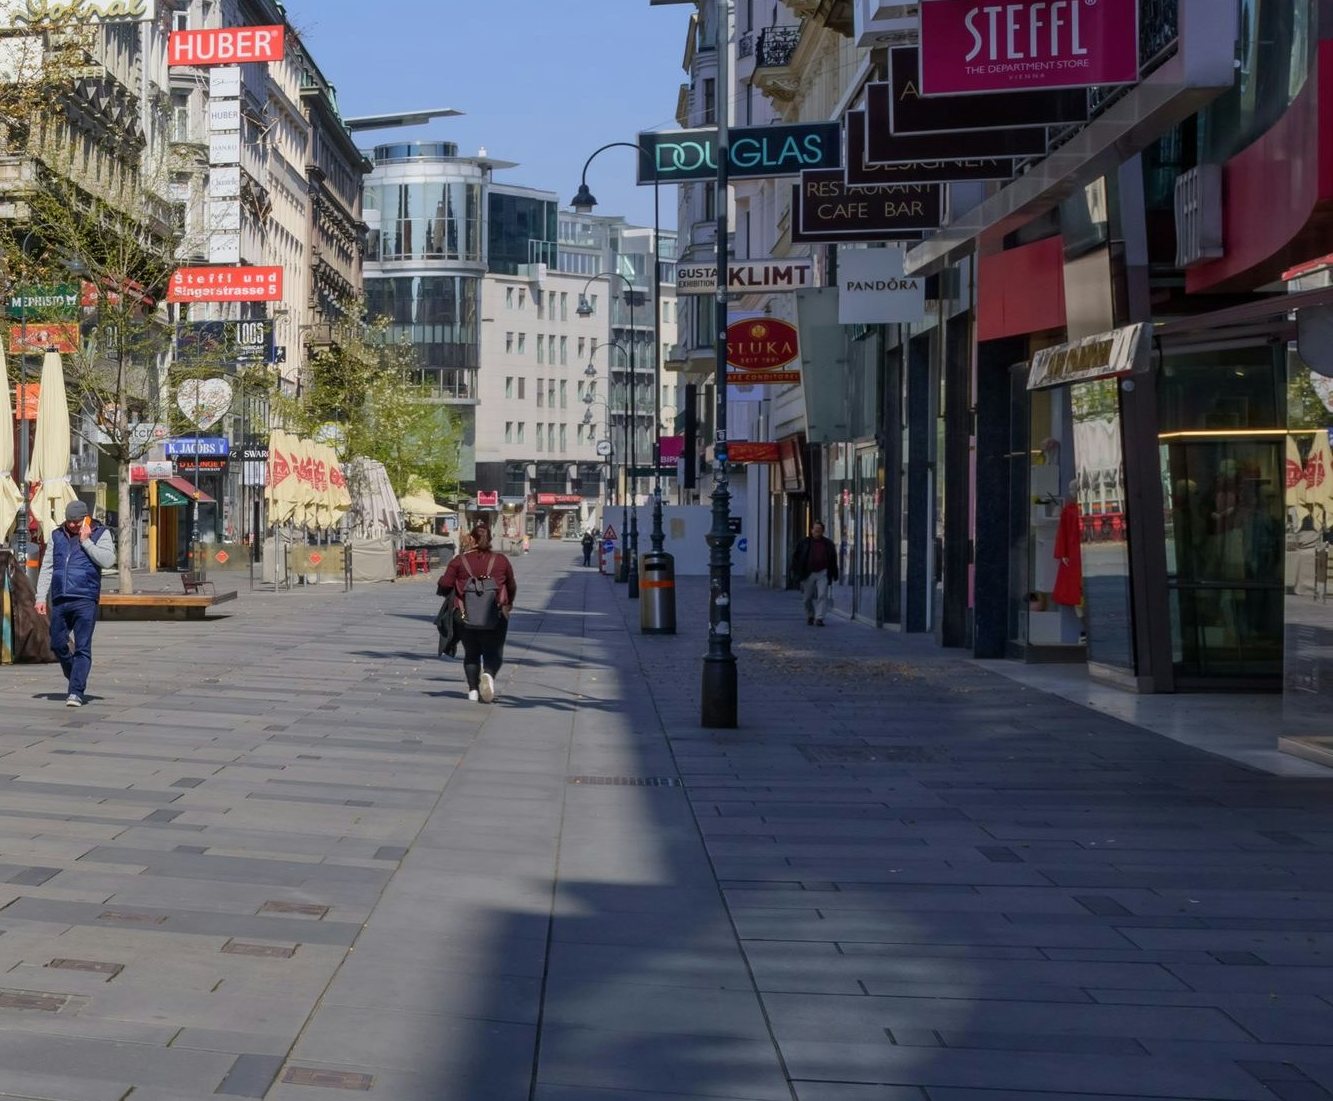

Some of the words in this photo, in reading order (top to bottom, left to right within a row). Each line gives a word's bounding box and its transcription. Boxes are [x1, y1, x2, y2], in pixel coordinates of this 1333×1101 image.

[965, 65, 985, 75] THE
[988, 60, 1054, 73] DEPARTMENT
[1057, 58, 1090, 69] STORE
[1008, 72, 1046, 81] VIENNA
[211, 110, 239, 120] HUBER
[655, 133, 823, 172] DOUGLAS
[817, 202, 868, 219] CAFE
[884, 201, 924, 218] BAR
[174, 273, 232, 284] Steffl
[243, 272, 277, 283] und
[728, 265, 811, 287] KLIMT
[174, 286, 265, 298] Singerstrasse
[268, 284, 277, 295] 5
[678, 279, 716, 289] EXHIBITION
[11, 296, 64, 308] MEPHISTO
[236, 322, 265, 344] LOOS
[726, 341, 793, 356] SLUKA
[180, 442, 216, 454] JACOBS
